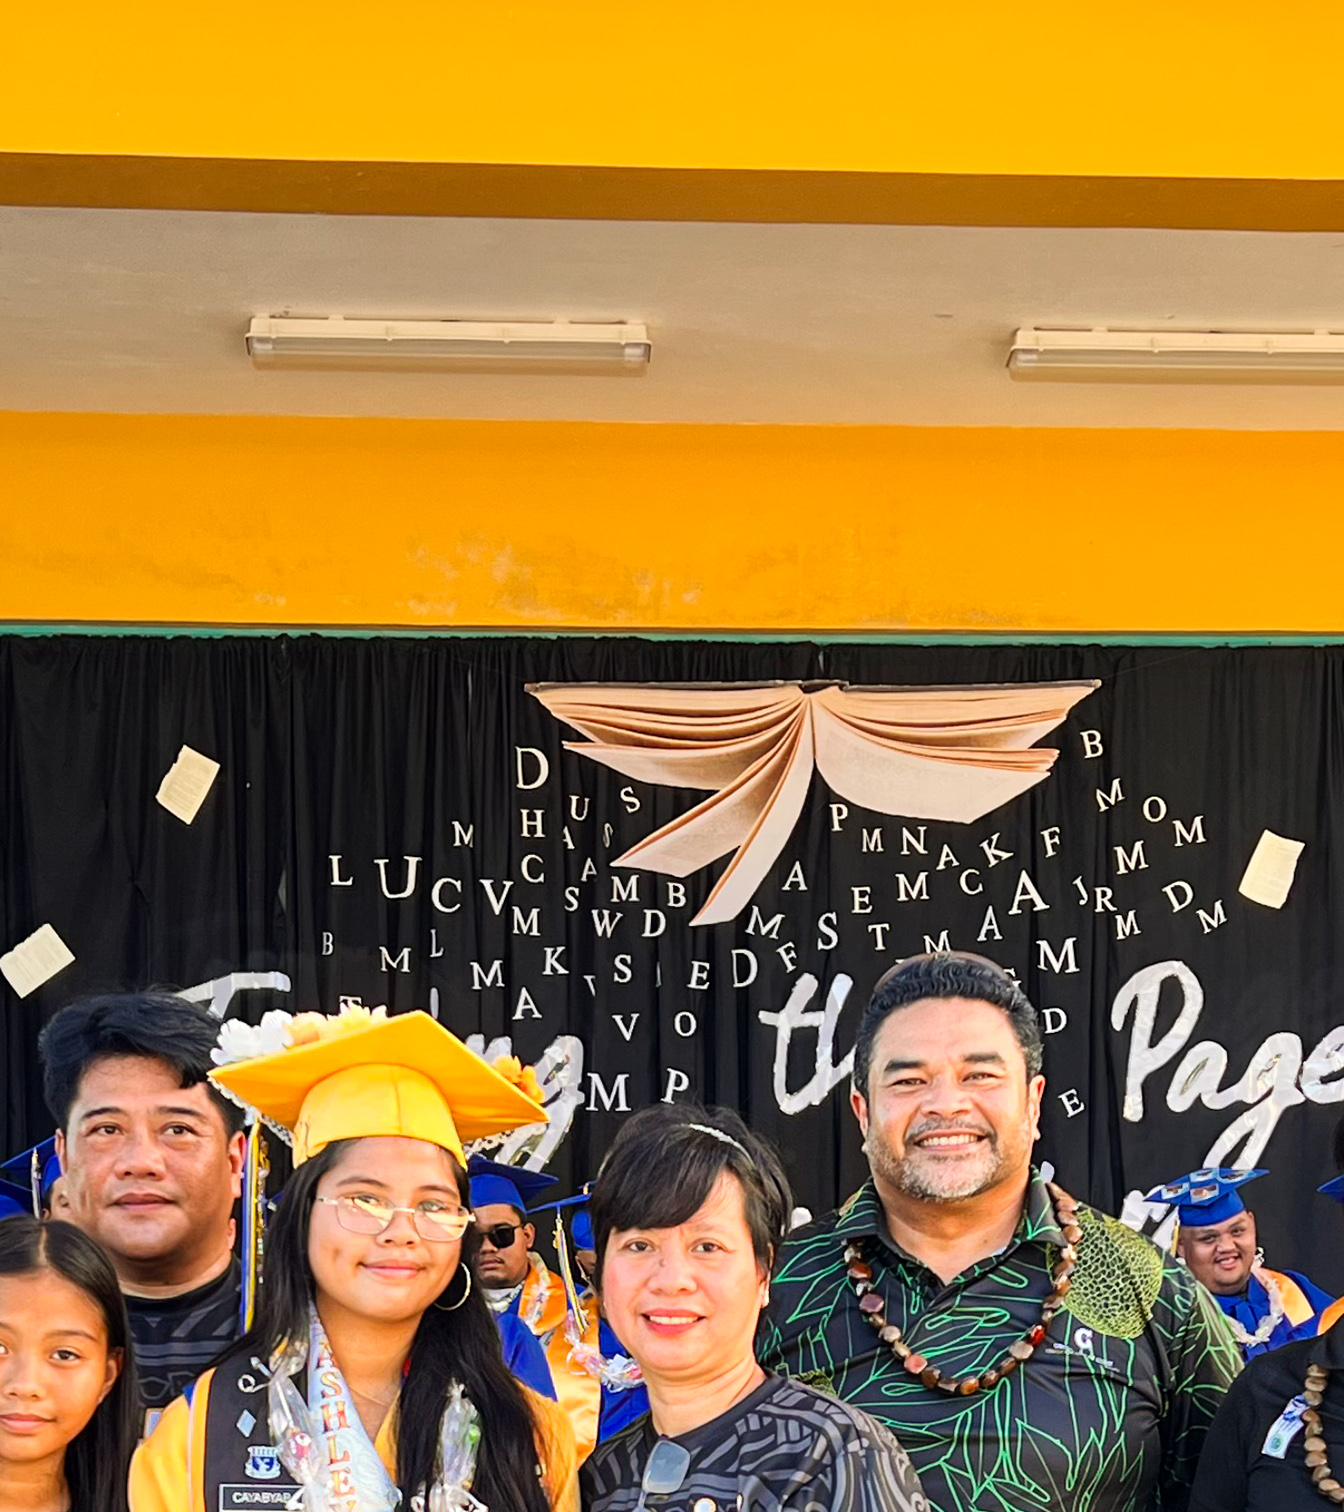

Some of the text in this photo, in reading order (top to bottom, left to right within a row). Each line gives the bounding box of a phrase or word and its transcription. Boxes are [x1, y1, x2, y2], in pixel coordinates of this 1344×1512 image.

[1079, 729, 1104, 759] B
[515, 746, 549, 790] D
[569, 795, 590, 821] U
[620, 786, 641, 813] S
[1096, 777, 1125, 812] M
[1142, 796, 1167, 823] O
[520, 808, 546, 838] H
[829, 803, 849, 832] P
[1172, 815, 1207, 847] M
[451, 820, 474, 847] M
[861, 827, 884, 853] M
[900, 825, 929, 855] N
[1040, 826, 1060, 858] F
[935, 843, 960, 871] A
[979, 832, 1014, 868] K
[1113, 839, 1150, 875] M
[328, 854, 354, 886] L
[373, 855, 423, 899] U
[521, 854, 545, 884] C
[580, 857, 597, 882] A
[781, 860, 808, 891] A
[959, 868, 984, 895] C
[431, 877, 462, 913] C
[478, 878, 514, 916] V
[564, 886, 580, 912] S
[610, 874, 640, 903] M
[666, 881, 687, 908] B
[850, 886, 873, 914] E
[894, 871, 930, 902] M
[1007, 869, 1051, 915] A
[1072, 875, 1089, 906] J
[1094, 886, 1118, 913] R
[1161, 880, 1194, 913] D
[511, 905, 541, 937] M
[591, 909, 624, 939] W
[641, 908, 666, 938] D
[745, 905, 786, 940] M
[817, 911, 839, 951] S
[976, 905, 1003, 942] A
[1114, 909, 1142, 940] M
[1195, 899, 1228, 935] M
[322, 931, 334, 956] B
[429, 928, 444, 958] L
[867, 923, 890, 951] T
[378, 946, 412, 973] M
[542, 946, 570, 976] K
[613, 954, 632, 983] S
[731, 948, 758, 988] D
[775, 941, 797, 974] F
[1035, 937, 1080, 974] M
[469, 959, 506, 990] M
[686, 960, 710, 990] E
[511, 986, 543, 1021] A
[611, 1013, 640, 1042] V
[674, 1011, 697, 1037] O
[1041, 1007, 1067, 1034] D
[585, 1072, 632, 1112] M
[660, 1067, 690, 1105] P
[1057, 1088, 1085, 1118] E
